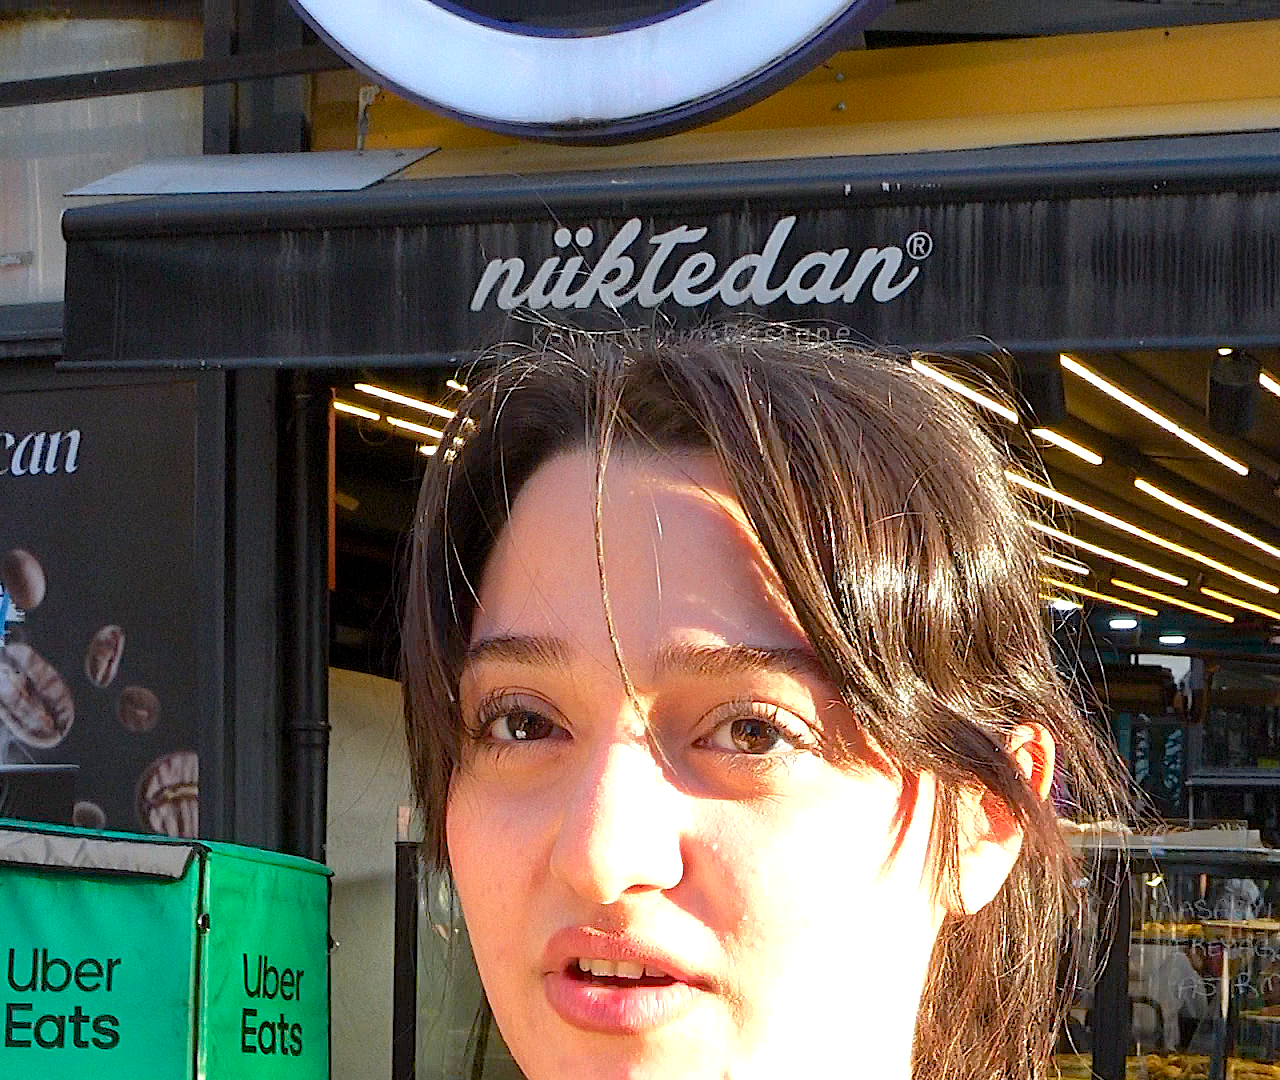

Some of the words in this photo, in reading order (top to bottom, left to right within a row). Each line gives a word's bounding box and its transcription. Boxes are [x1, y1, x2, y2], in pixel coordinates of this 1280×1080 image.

[7, 948, 121, 993] Uber
[242, 953, 304, 1001] Uber
[5, 1003, 120, 1050] Eats
[241, 1008, 303, 1057] Eats
